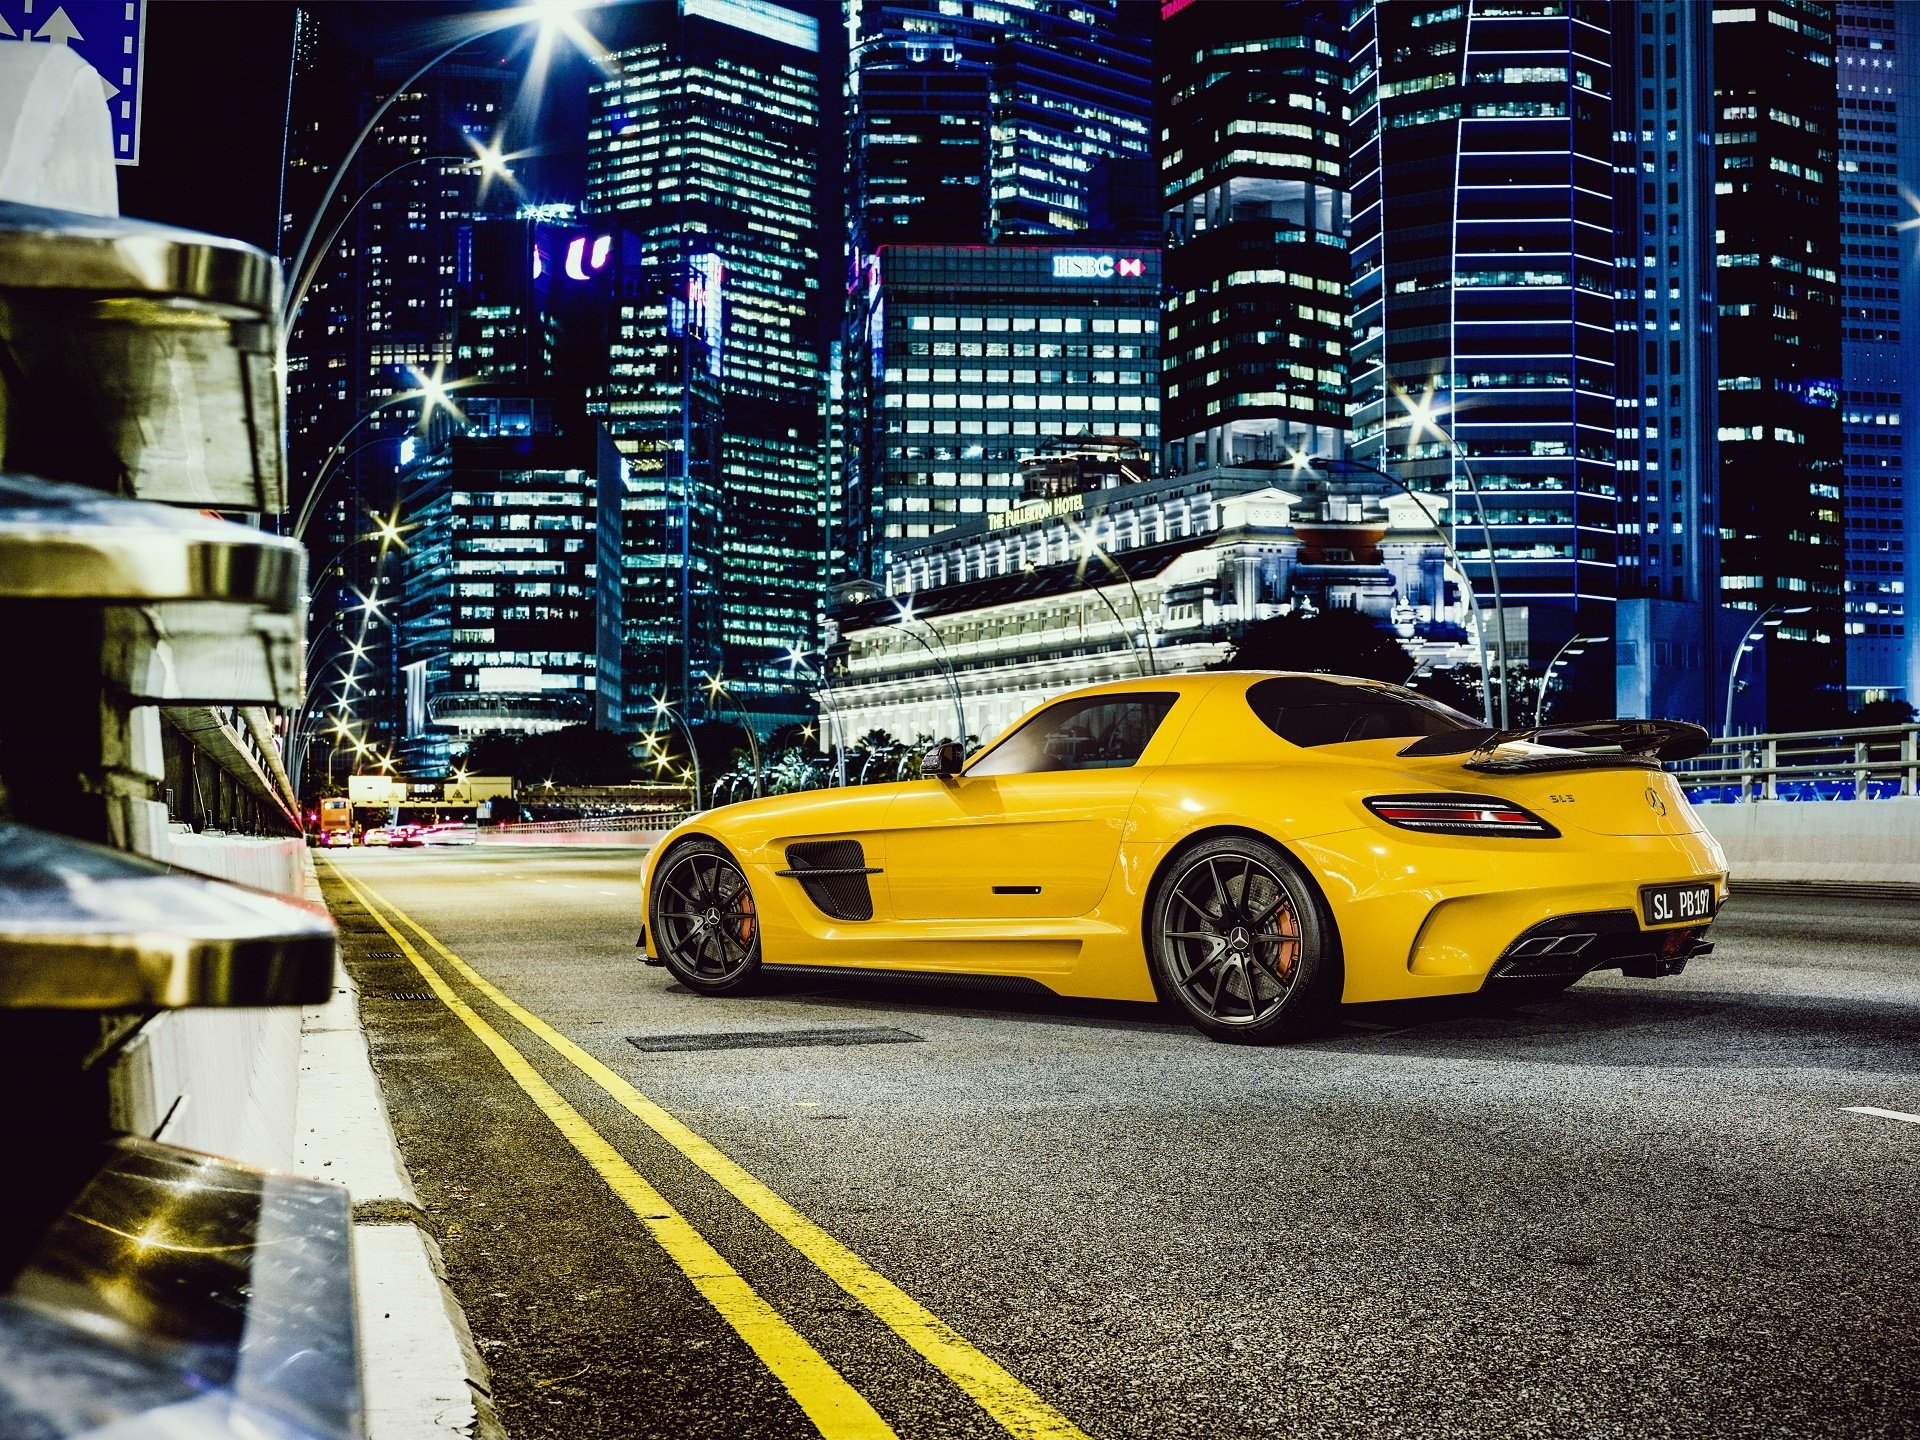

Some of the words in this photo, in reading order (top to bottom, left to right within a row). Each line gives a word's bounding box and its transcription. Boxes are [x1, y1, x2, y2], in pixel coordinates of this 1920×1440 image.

[1053, 255, 1114, 278] HSBC
[988, 513, 1005, 531] THE
[1005, 501, 1053, 527] FULLERTON
[1053, 494, 1084, 515] HOTEL
[414, 783, 436, 793] ERP
[1549, 794, 1575, 803] SLS
[1654, 893, 1673, 920] SL
[1679, 888, 1710, 917] PB197
